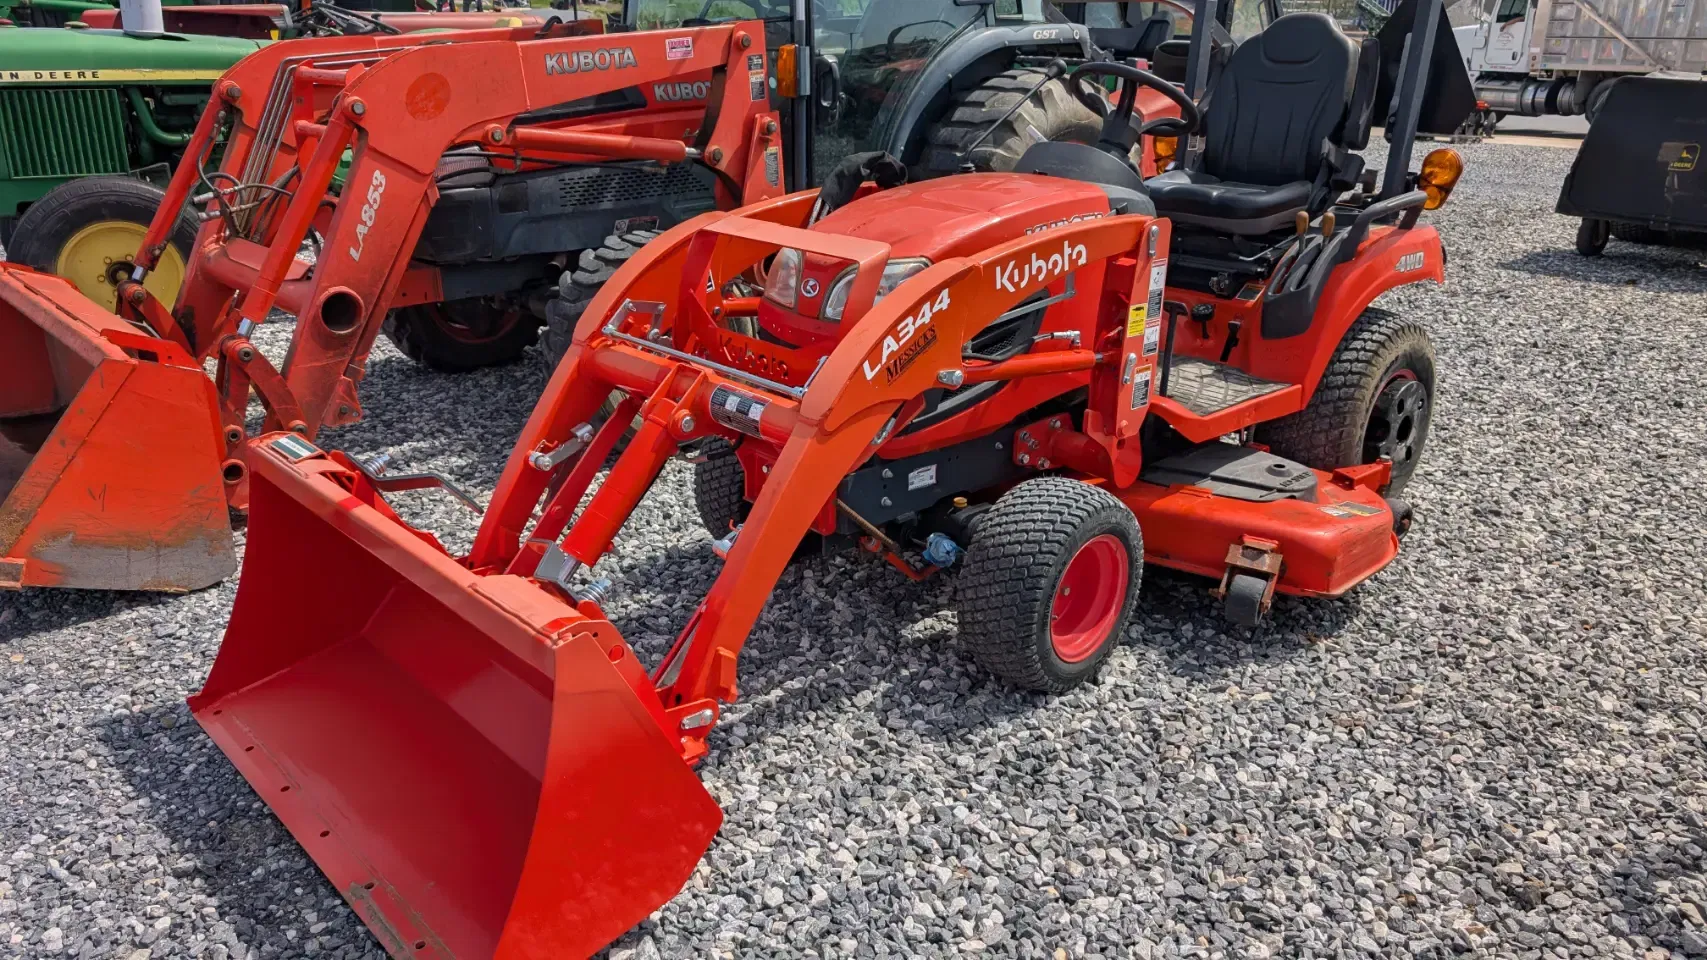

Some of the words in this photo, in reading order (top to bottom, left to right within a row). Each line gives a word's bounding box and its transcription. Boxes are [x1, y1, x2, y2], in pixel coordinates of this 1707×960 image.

[1033, 28, 1059, 40] GST
[0, 71, 19, 80] N
[34, 71, 100, 80] DEERE
[545, 47, 638, 76] KUBOTA
[653, 80, 711, 101] KUBO
[349, 169, 386, 262] LA853
[995, 240, 1087, 293] Kubota
[1394, 250, 1425, 273] 4WD
[862, 287, 951, 381] LA344
[719, 333, 789, 380] Kubota
